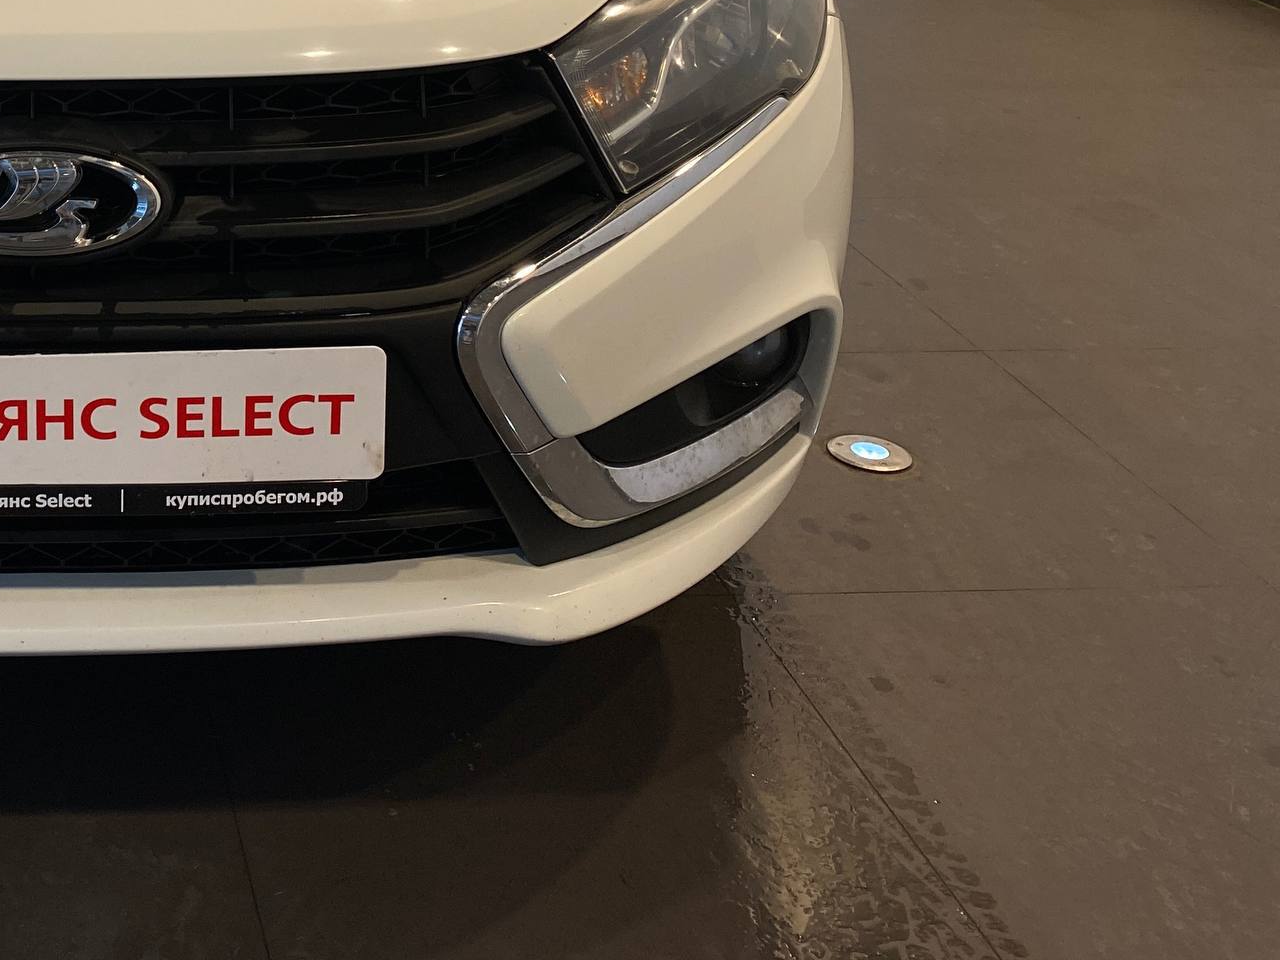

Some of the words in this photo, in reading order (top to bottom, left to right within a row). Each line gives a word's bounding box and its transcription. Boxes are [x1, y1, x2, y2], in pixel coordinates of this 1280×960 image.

[138, 393, 356, 440] SELECT
[35, 493, 93, 509] Select
[165, 488, 345, 510] куписпробегом.рф
